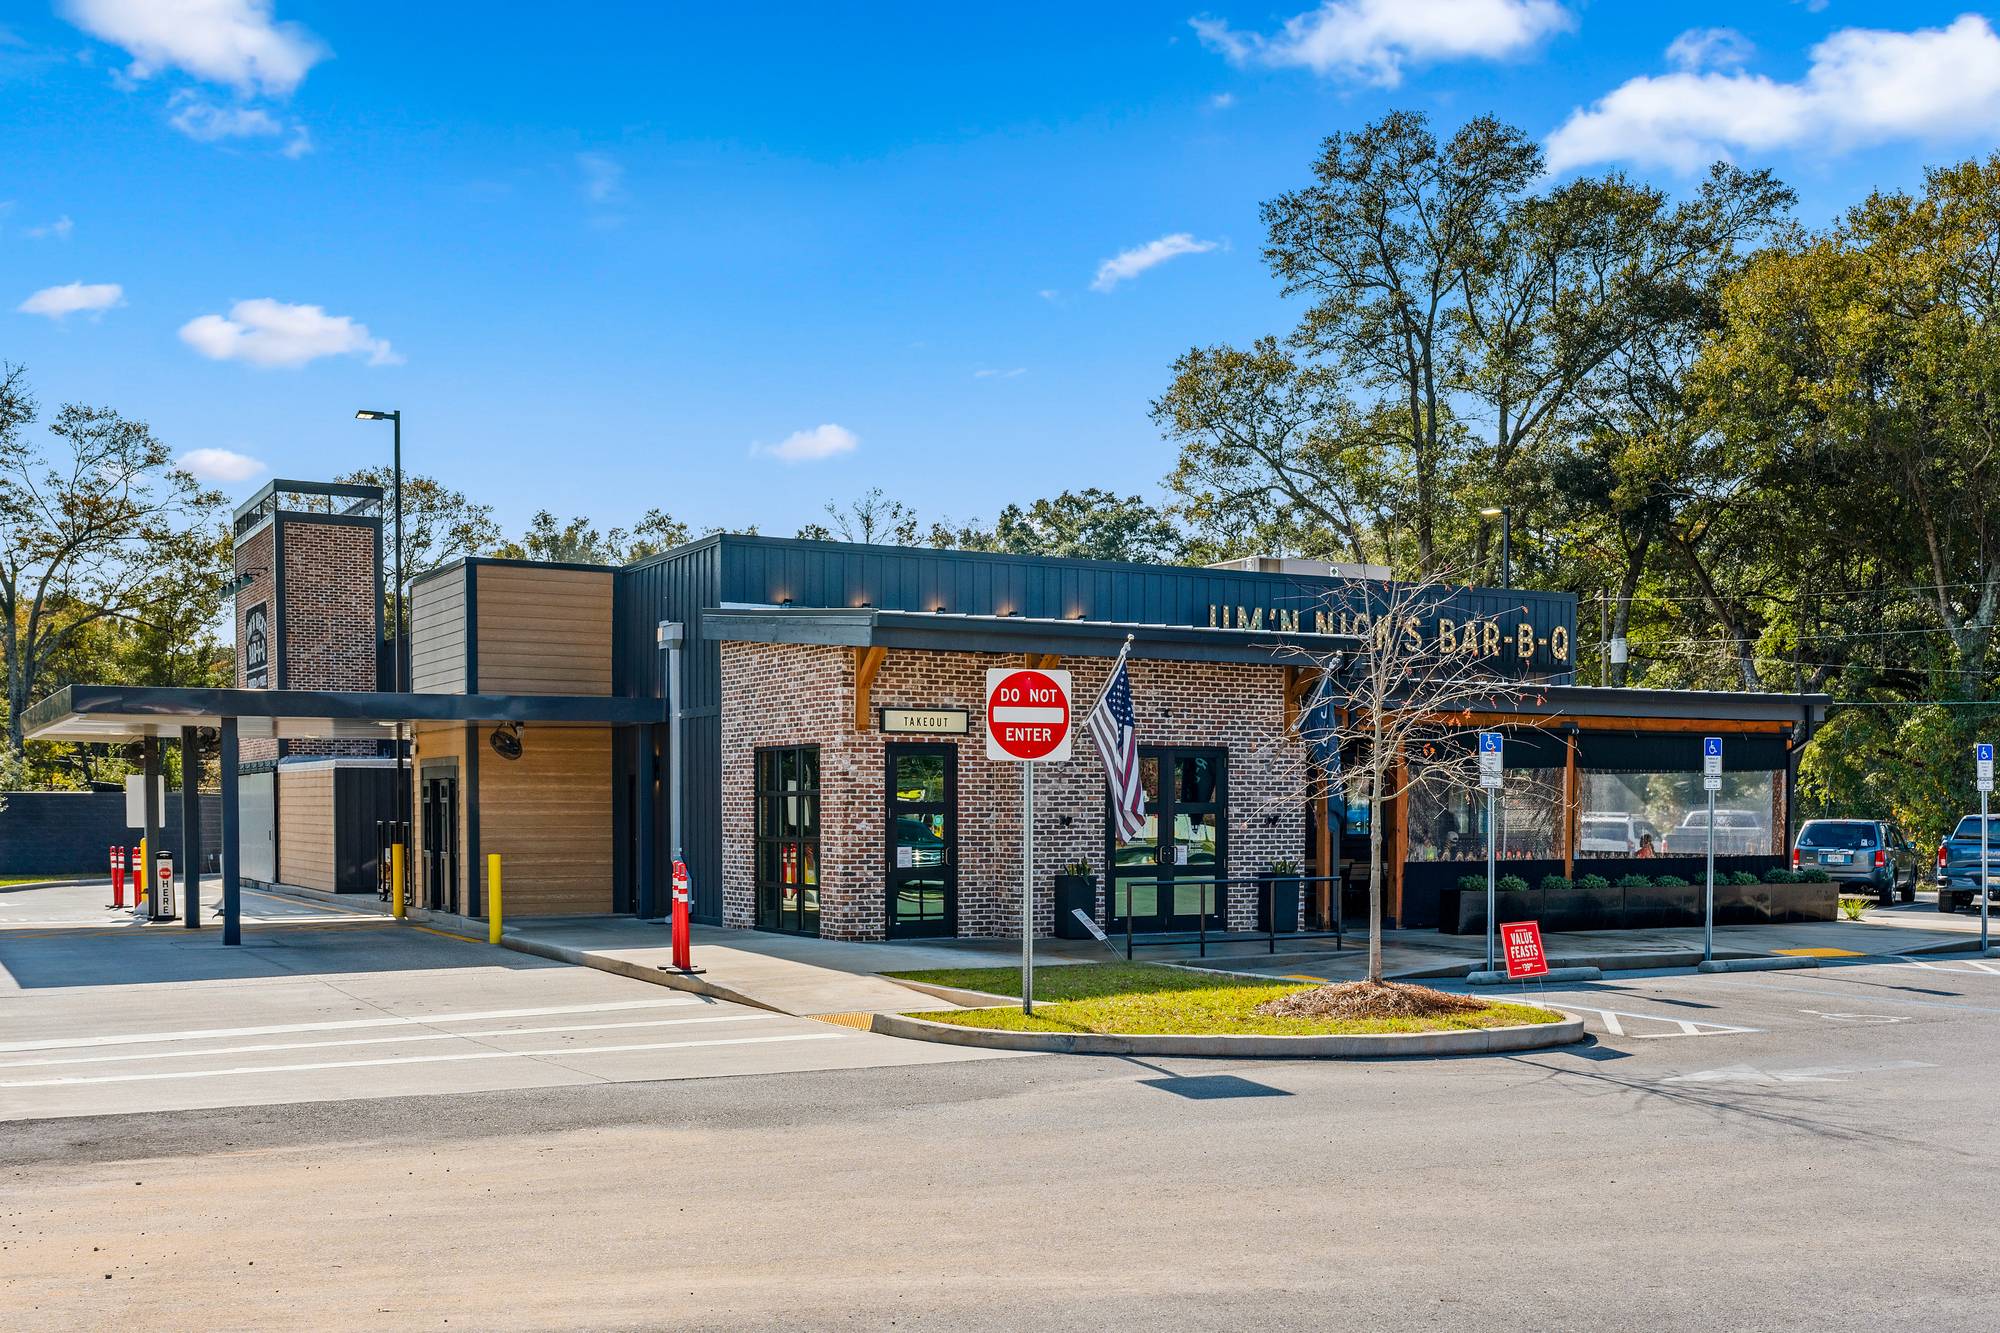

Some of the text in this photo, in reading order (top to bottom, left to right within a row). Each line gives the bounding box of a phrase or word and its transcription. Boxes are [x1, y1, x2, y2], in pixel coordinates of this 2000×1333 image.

[1439, 617, 1570, 661] BAR-B-Q
[1000, 688, 1057, 702] DO NOT
[904, 716, 949, 727] TAKEOUT
[1005, 728, 1052, 742] ENTER
[1510, 932, 1534, 945] VALUE
[1511, 944, 1538, 958] FEASTS
